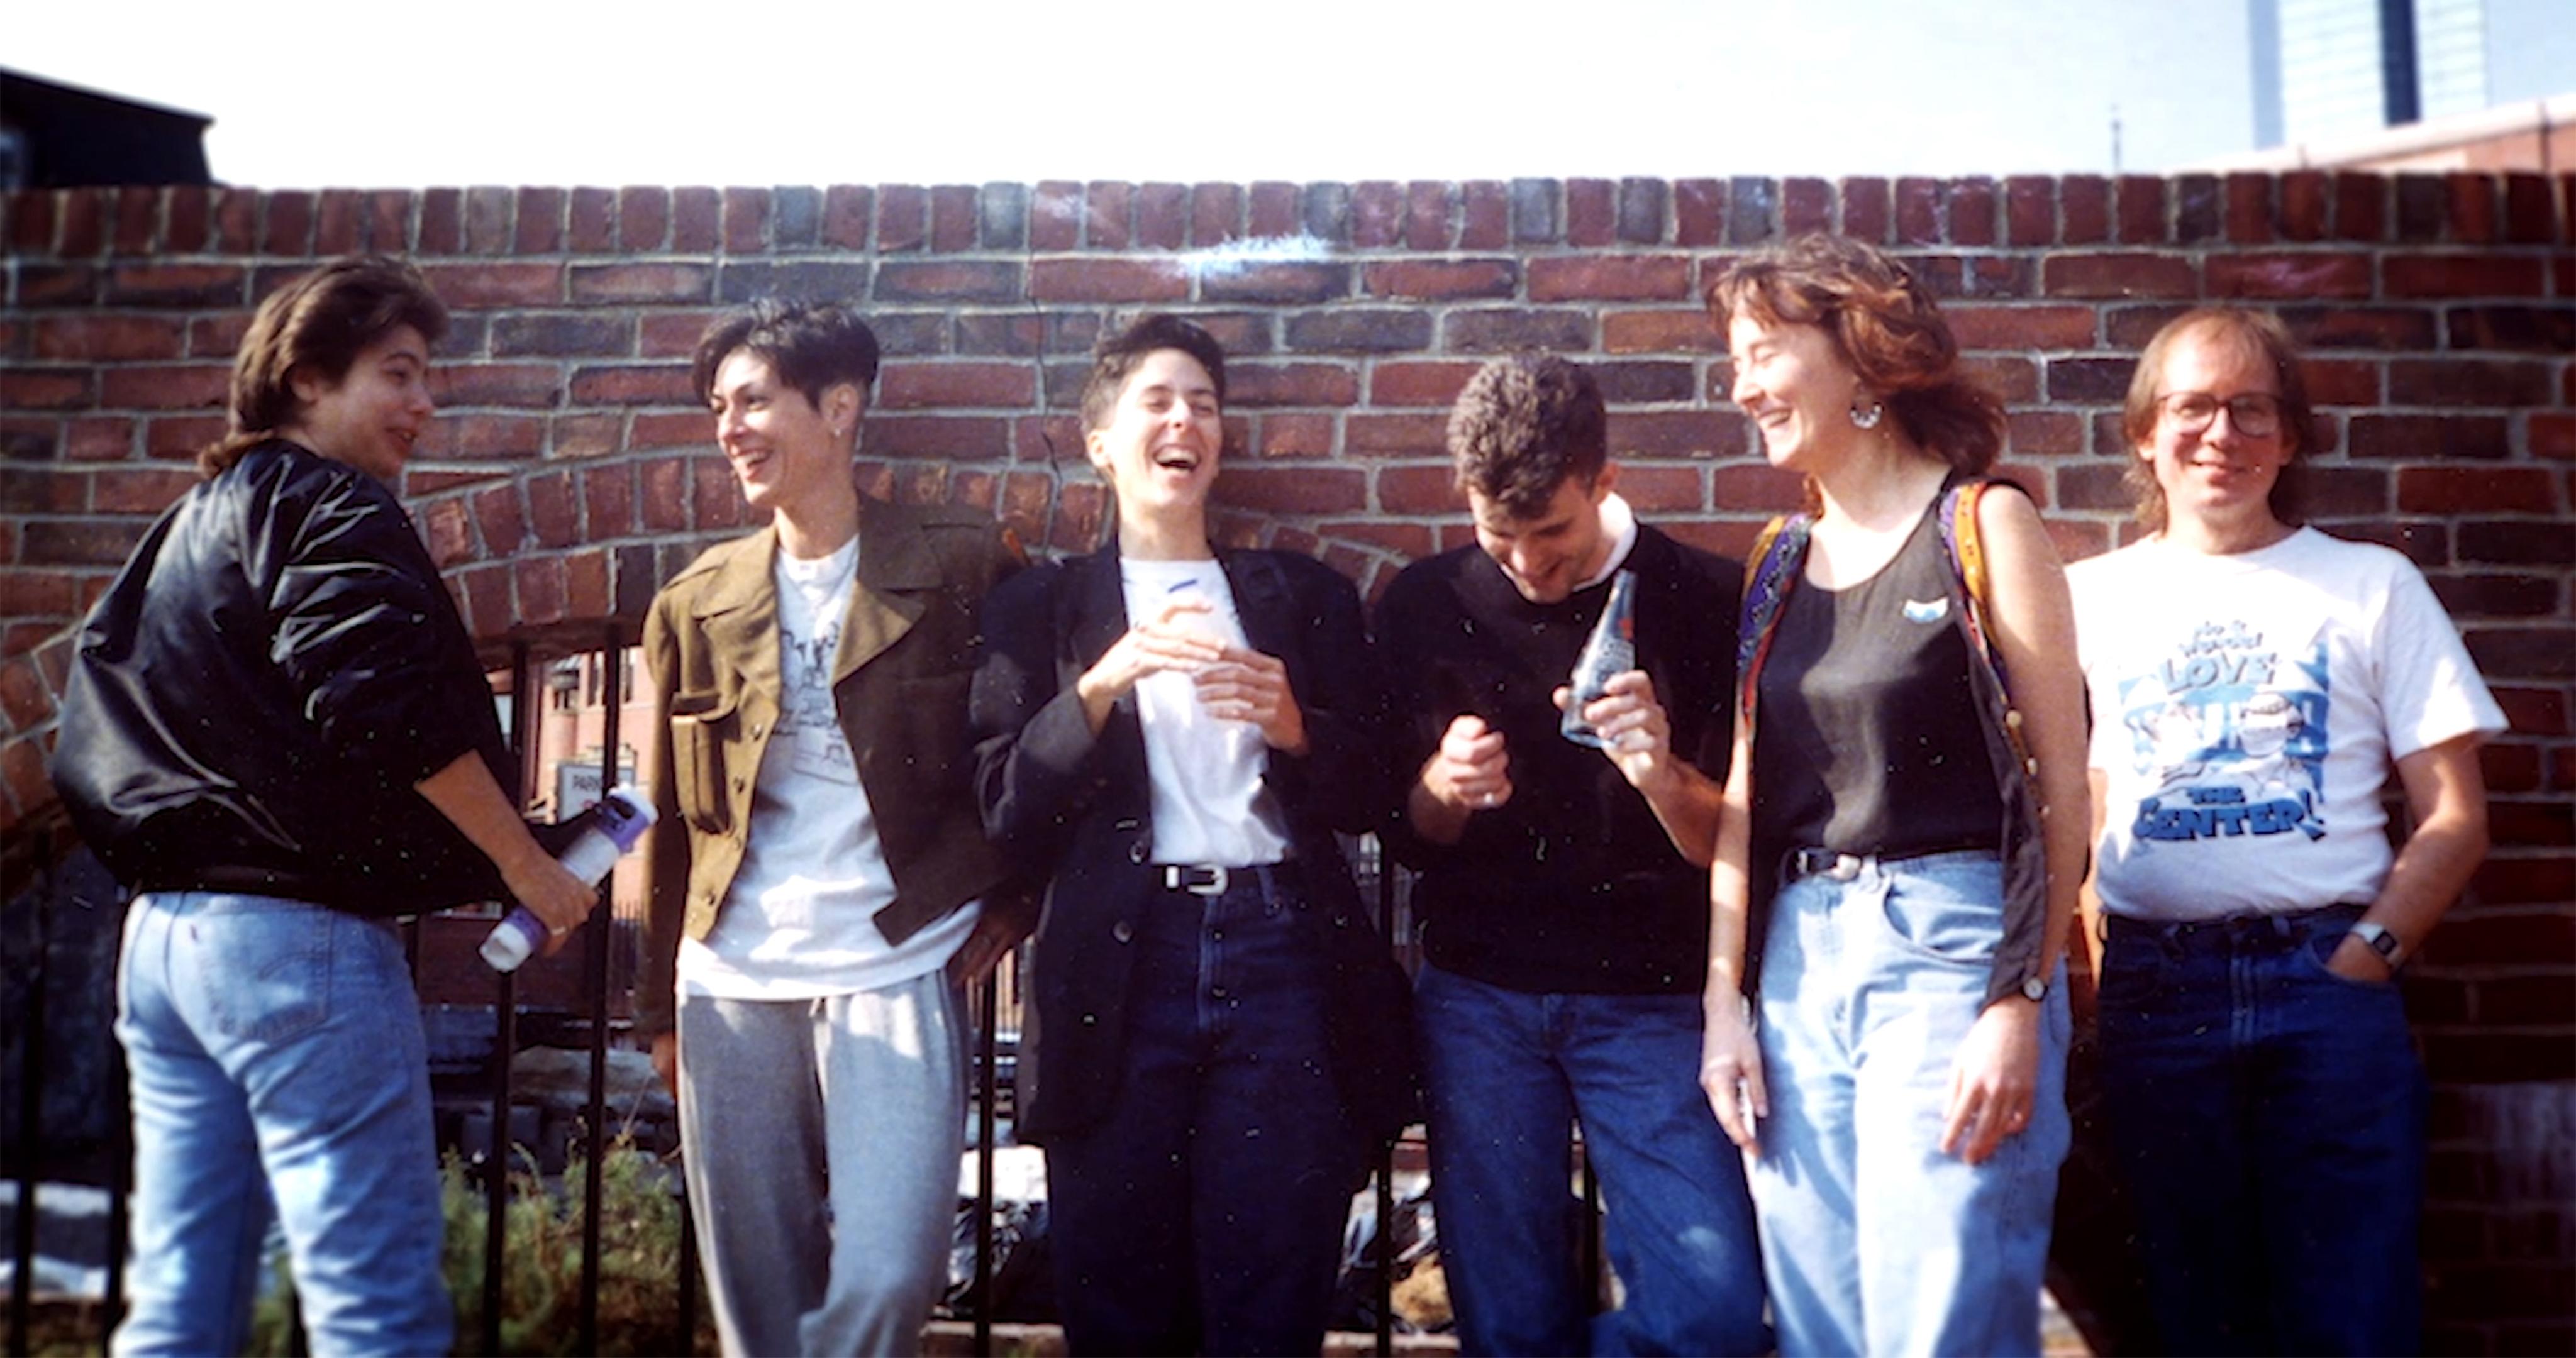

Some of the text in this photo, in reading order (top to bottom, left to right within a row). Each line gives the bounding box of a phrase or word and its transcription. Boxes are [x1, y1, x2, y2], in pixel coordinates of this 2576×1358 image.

[2158, 652, 2277, 695] LOVE
[572, 774, 602, 792] PARK
[2186, 786, 2245, 805] THE
